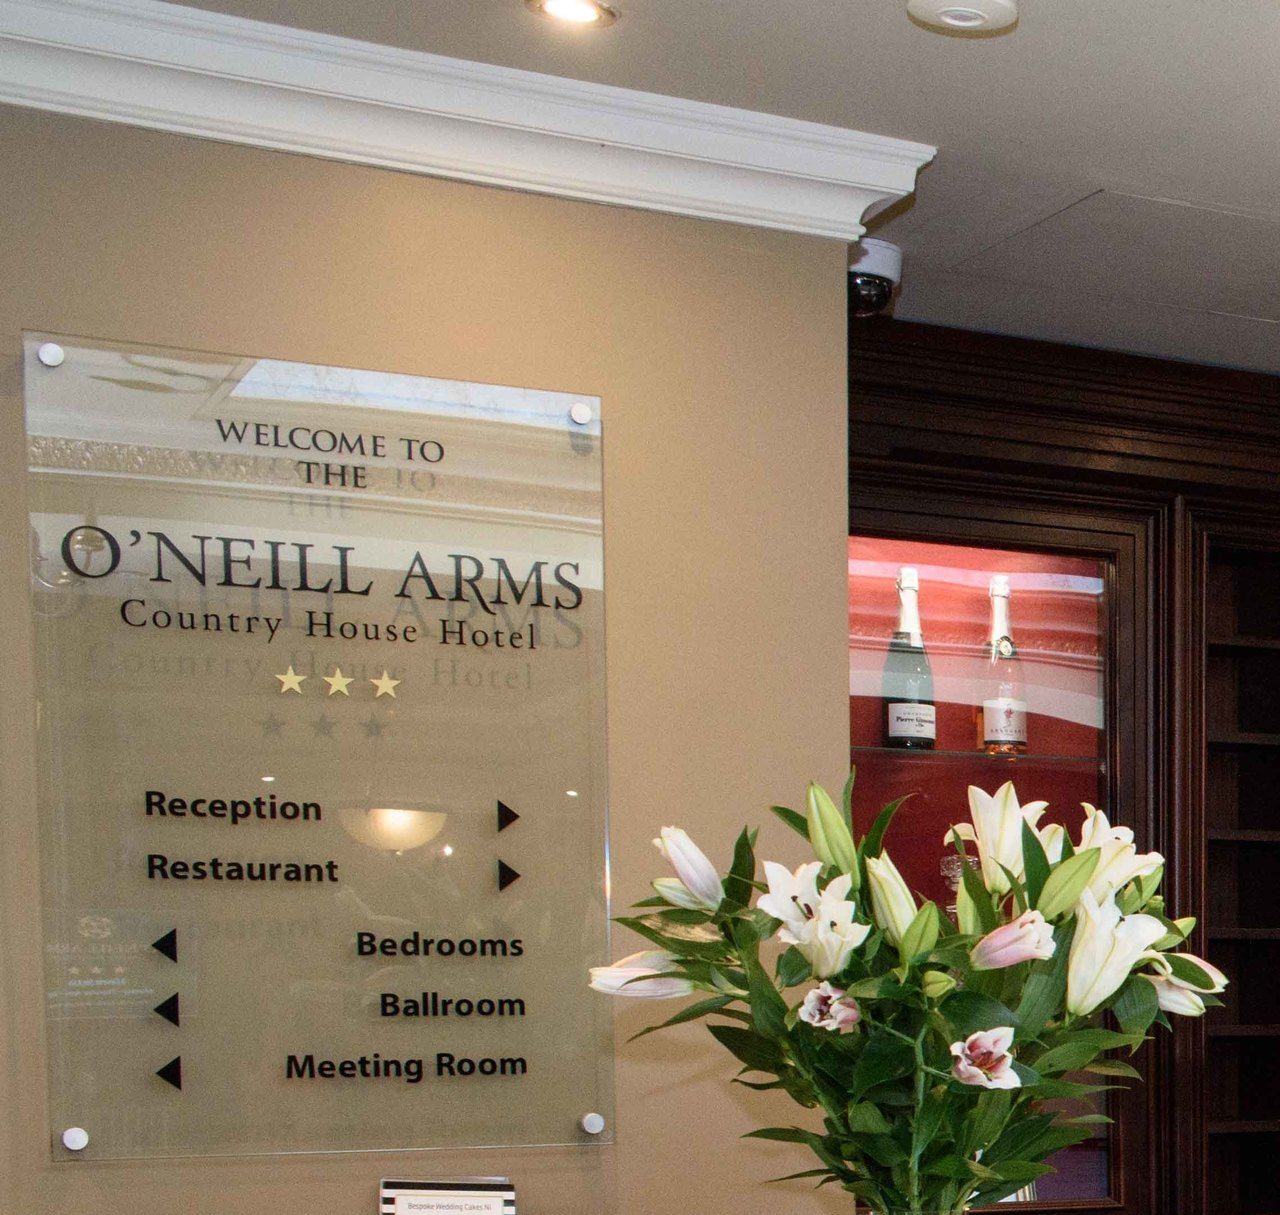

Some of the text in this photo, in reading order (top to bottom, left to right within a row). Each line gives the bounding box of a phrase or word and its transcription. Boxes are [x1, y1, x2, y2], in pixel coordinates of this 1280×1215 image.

[215, 418, 445, 463] WELCOME TO
[298, 460, 367, 489] THE
[61, 525, 584, 616] O'NEILL ARMS
[119, 599, 535, 650] Country House Hotel
[145, 790, 322, 825] Reception
[147, 854, 338, 883] Restaurant
[357, 931, 524, 957] Bedrooms
[380, 992, 526, 1018] Ballroom
[286, 1052, 527, 1084] Meeting Room
[436, 1203, 463, 1212] Wedding
